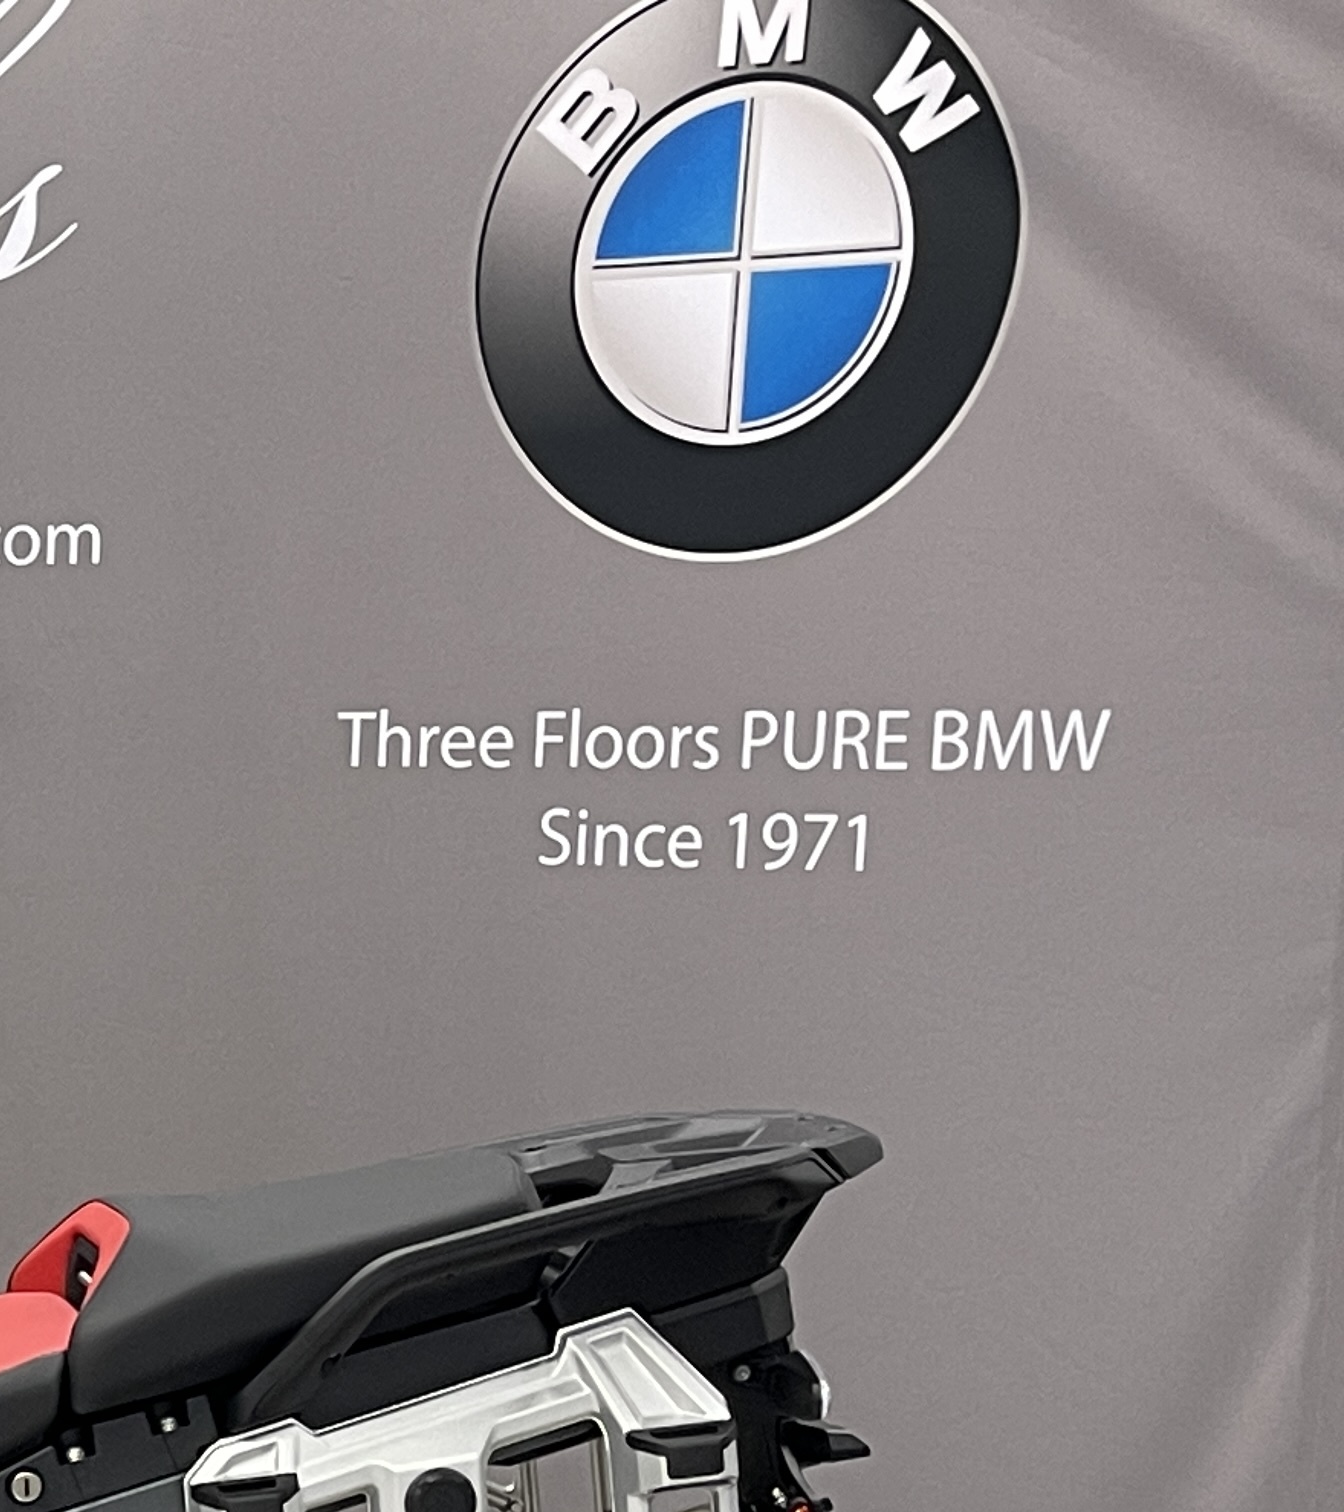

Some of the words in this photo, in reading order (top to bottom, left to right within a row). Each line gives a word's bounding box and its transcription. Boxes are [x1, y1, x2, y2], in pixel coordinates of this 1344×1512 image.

[536, 0, 981, 177] BMW
[337, 708, 514, 769] Three
[534, 707, 720, 770] Floors
[741, 709, 911, 770] PURE
[931, 709, 1112, 771] BMW
[538, 807, 704, 869] Since
[728, 812, 869, 872] 1971
